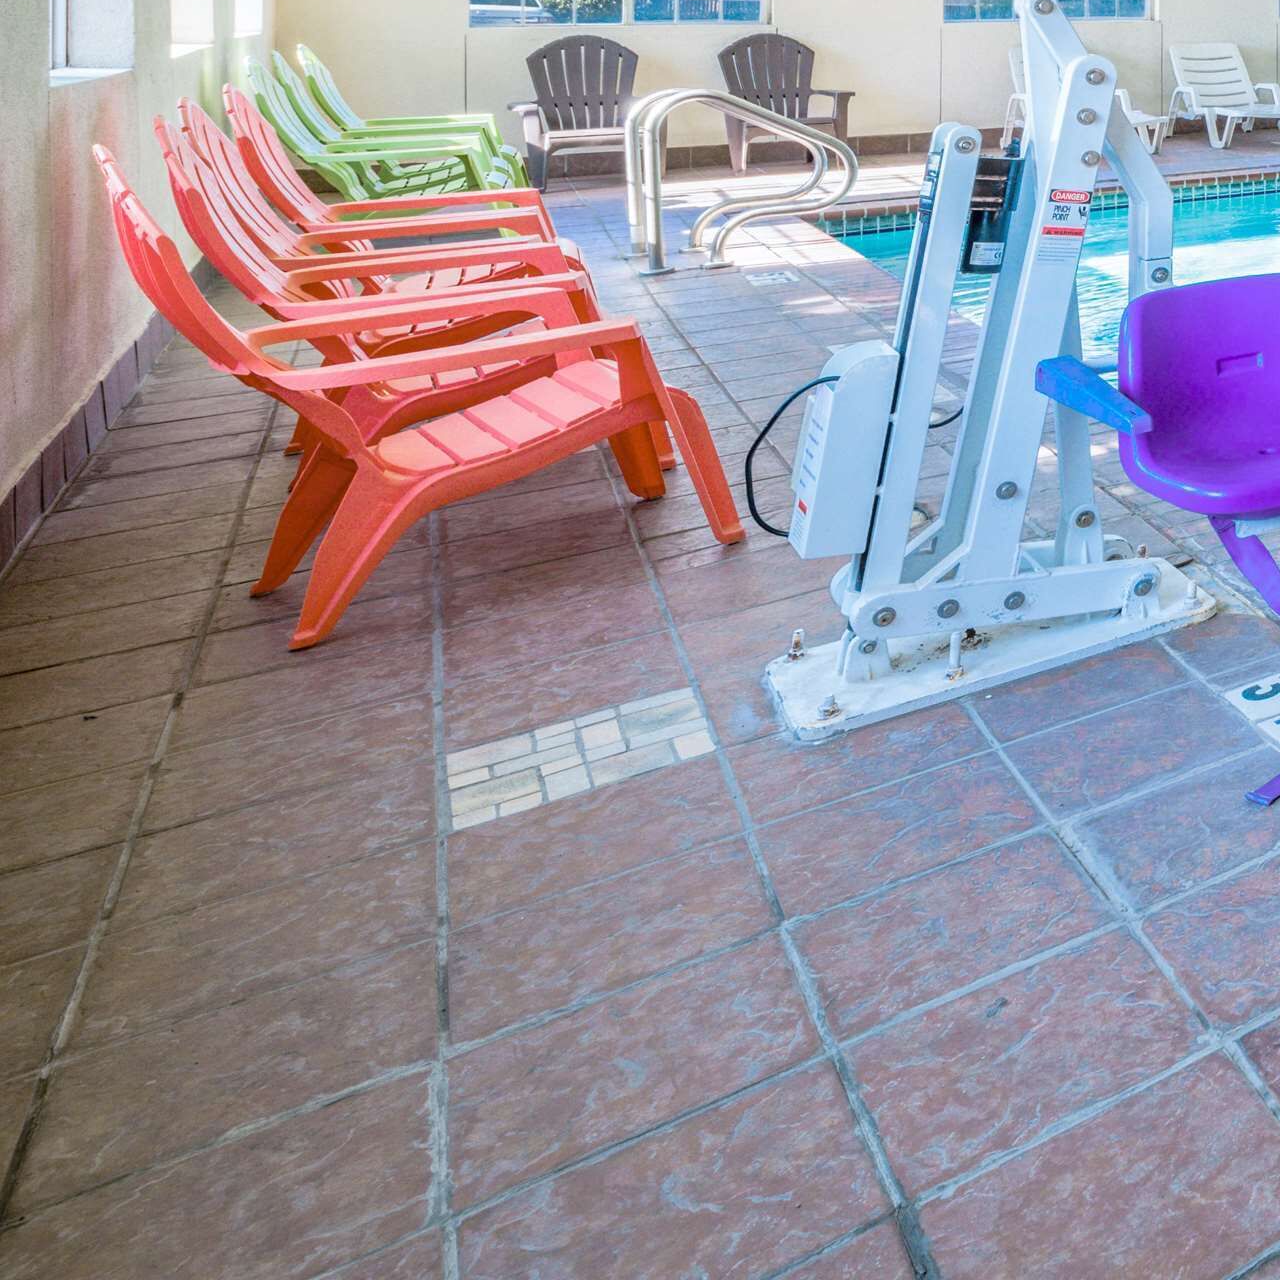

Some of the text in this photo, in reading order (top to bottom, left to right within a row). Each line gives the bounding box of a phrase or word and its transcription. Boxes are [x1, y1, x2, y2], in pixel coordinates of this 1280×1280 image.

[1056, 192, 1086, 201] DANGER
[1054, 205, 1071, 213] PINCH
[1052, 213, 1070, 221] POINT
